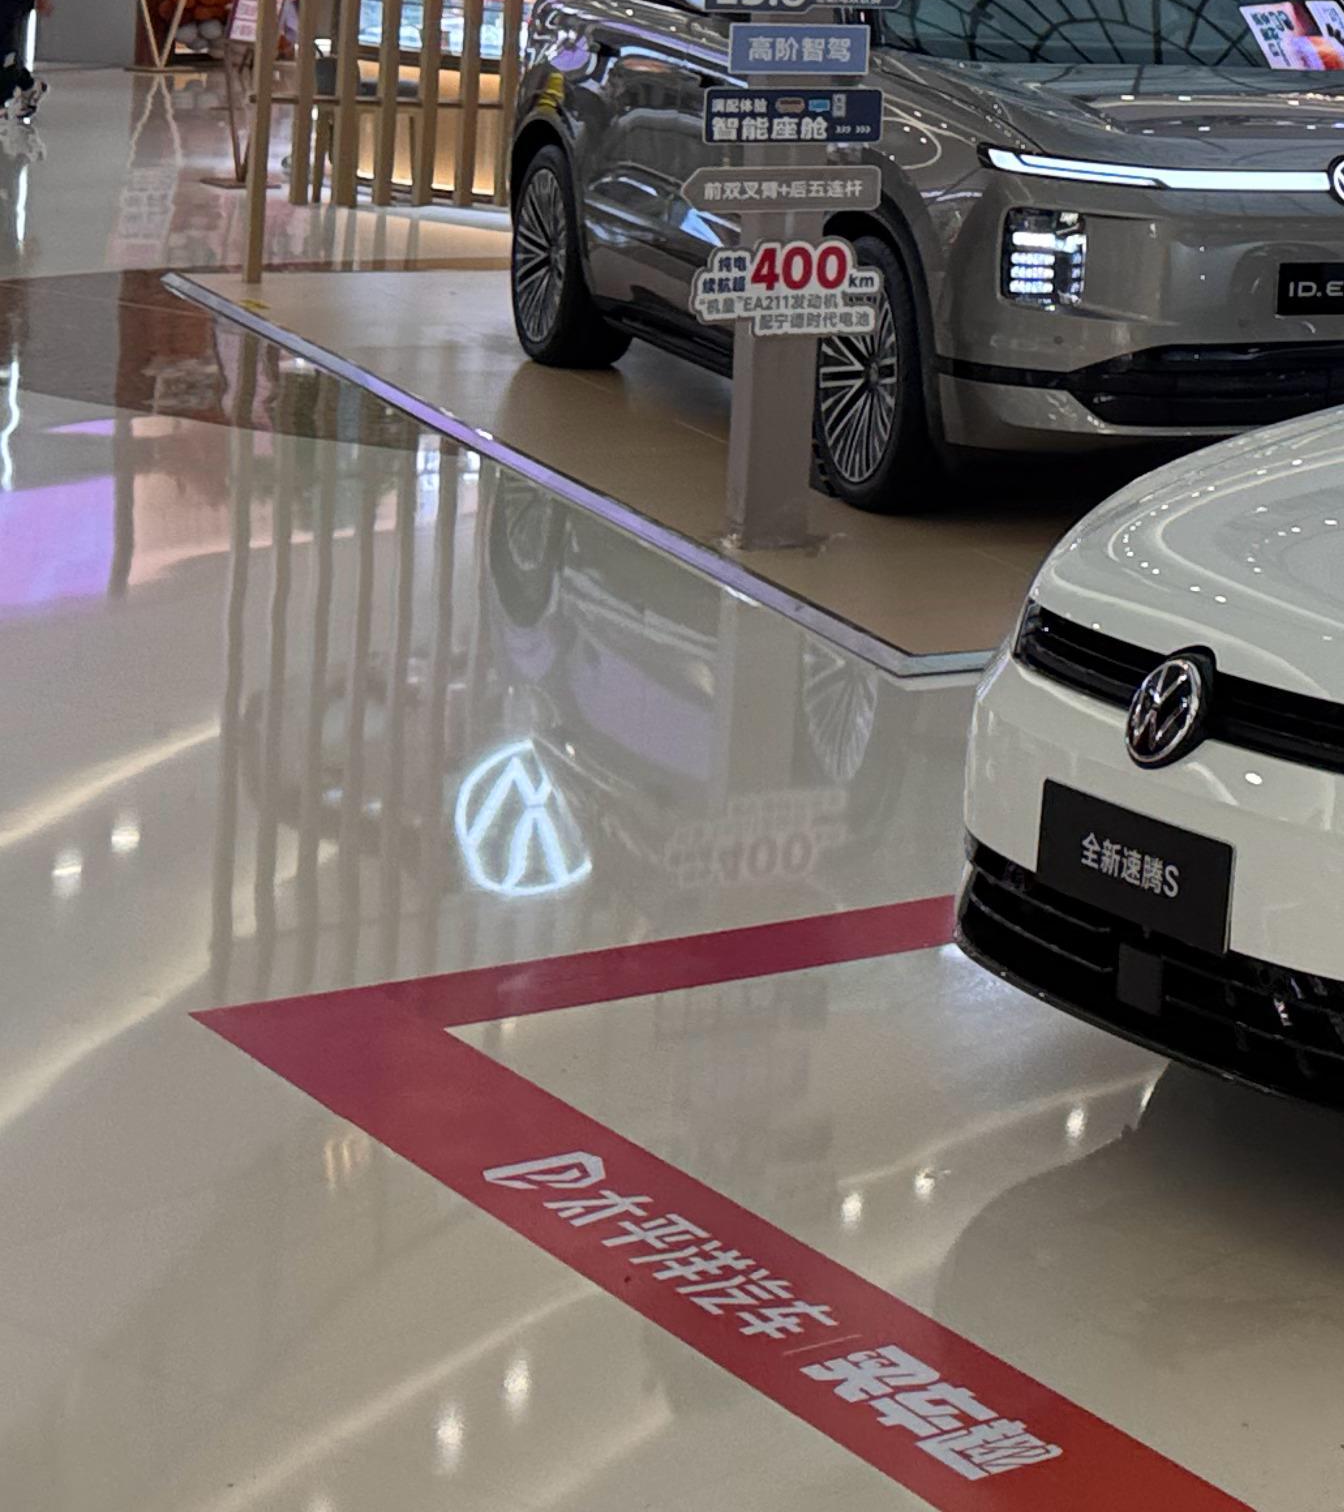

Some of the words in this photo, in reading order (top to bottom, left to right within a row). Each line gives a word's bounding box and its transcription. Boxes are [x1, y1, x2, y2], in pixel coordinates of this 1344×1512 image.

[748, 36, 852, 63] 高阶智驾
[711, 115, 828, 141] 智能座舱
[703, 179, 863, 201] 前双叉臂+后五连杆
[751, 245, 848, 291] 400
[848, 273, 875, 288] km
[1080, 831, 1180, 899] 全新速腾S
[543, 1189, 839, 1339] 太平洋汽车
